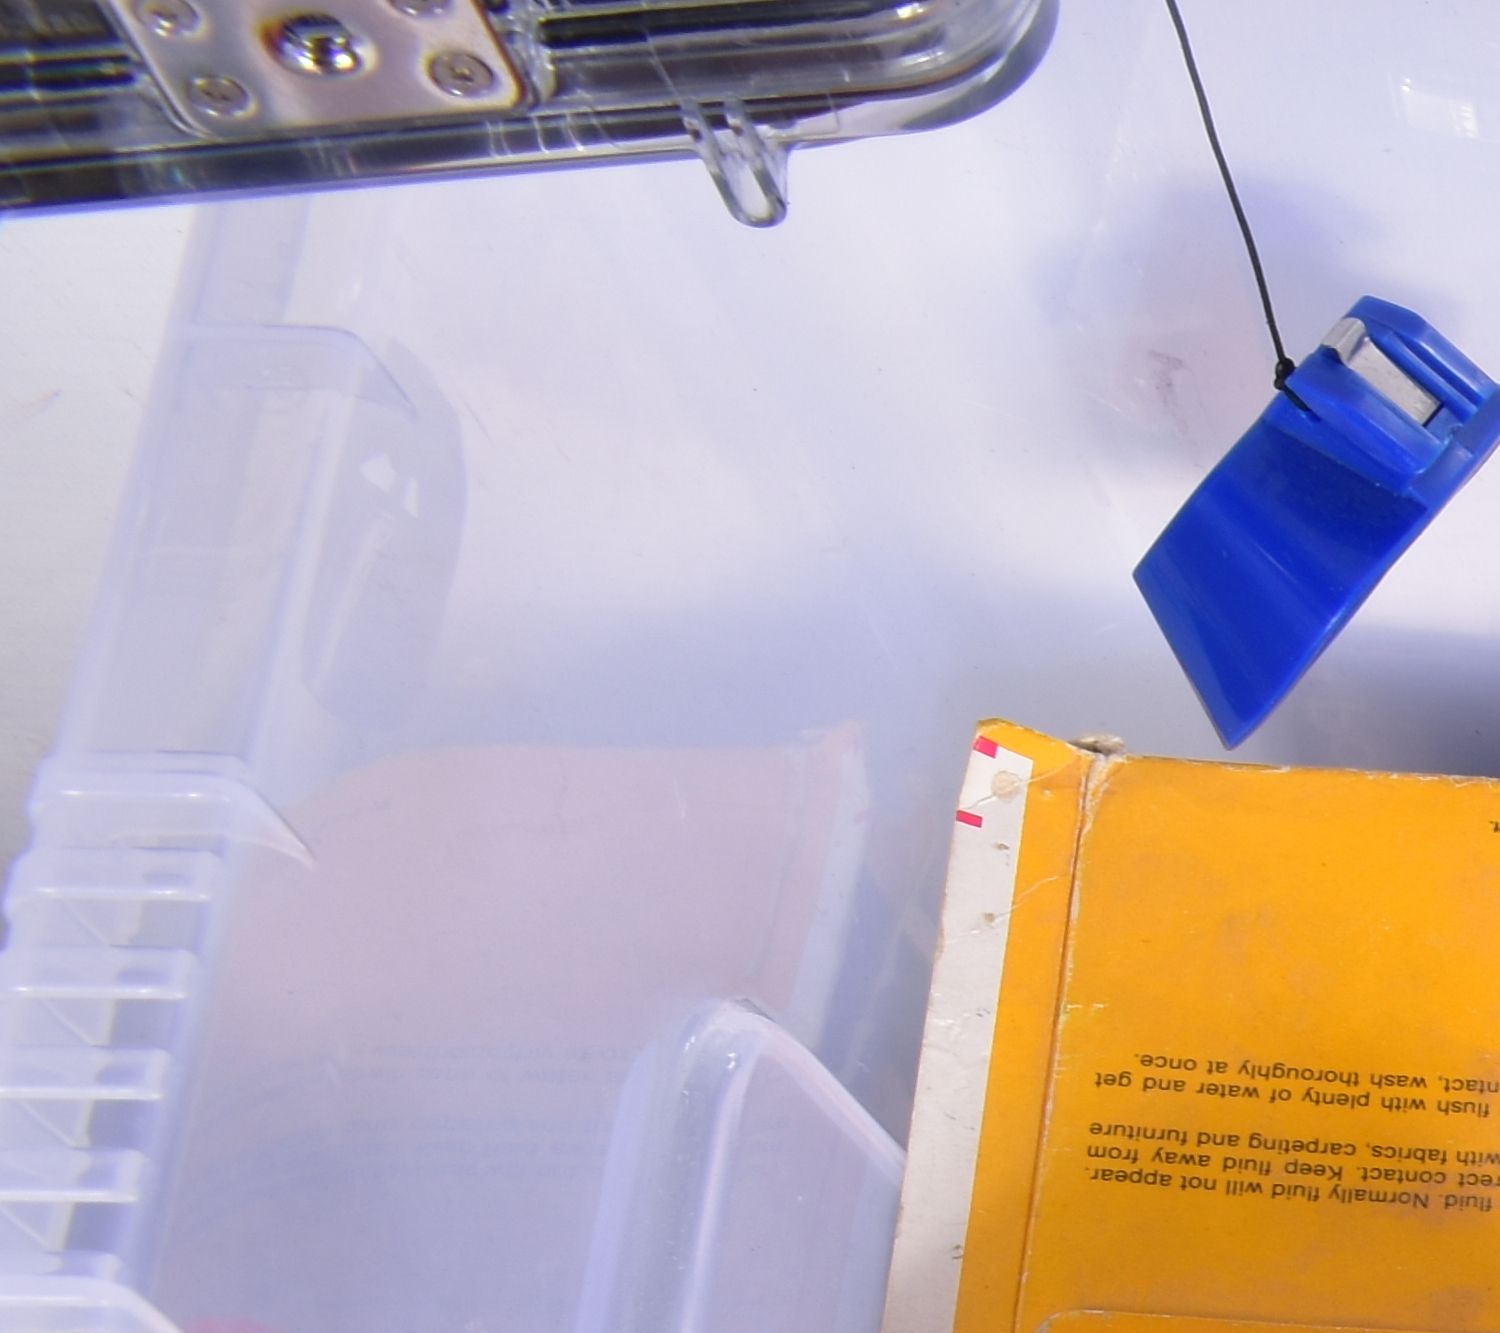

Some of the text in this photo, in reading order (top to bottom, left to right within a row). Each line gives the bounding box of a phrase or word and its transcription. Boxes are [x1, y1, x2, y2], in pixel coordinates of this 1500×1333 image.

[1121, 1052, 1199, 1075] once.
[1204, 1059, 1230, 1077] at
[1236, 1058, 1361, 1089] thoroughly
[1092, 1070, 1134, 1090] get
[1140, 1075, 1188, 1094] and
[1193, 1080, 1262, 1101] water
[1368, 1071, 1429, 1091] wash
[1267, 1086, 1294, 1106] of
[1299, 1085, 1372, 1111] plenty
[1379, 1095, 1428, 1114] with
[1435, 1098, 1492, 1120] flush
[1087, 1120, 1190, 1149] furniture
[1194, 1130, 1242, 1149] and
[1246, 1130, 1359, 1158] carpeting
[1085, 1143, 1140, 1166] from
[1149, 1145, 1213, 1169] away
[1364, 1141, 1449, 1167] fabrics,
[1083, 1166, 1174, 1189] appear.
[1220, 1155, 1273, 1178] fluid
[1282, 1157, 1345, 1183] Keep
[1355, 1165, 1449, 1186] contact.
[1178, 1174, 1219, 1193] not
[1224, 1178, 1265, 1198] will
[1268, 1182, 1322, 1204] fluid
[1327, 1182, 1431, 1210] Normally
[1442, 1192, 1494, 1214] fluid.
